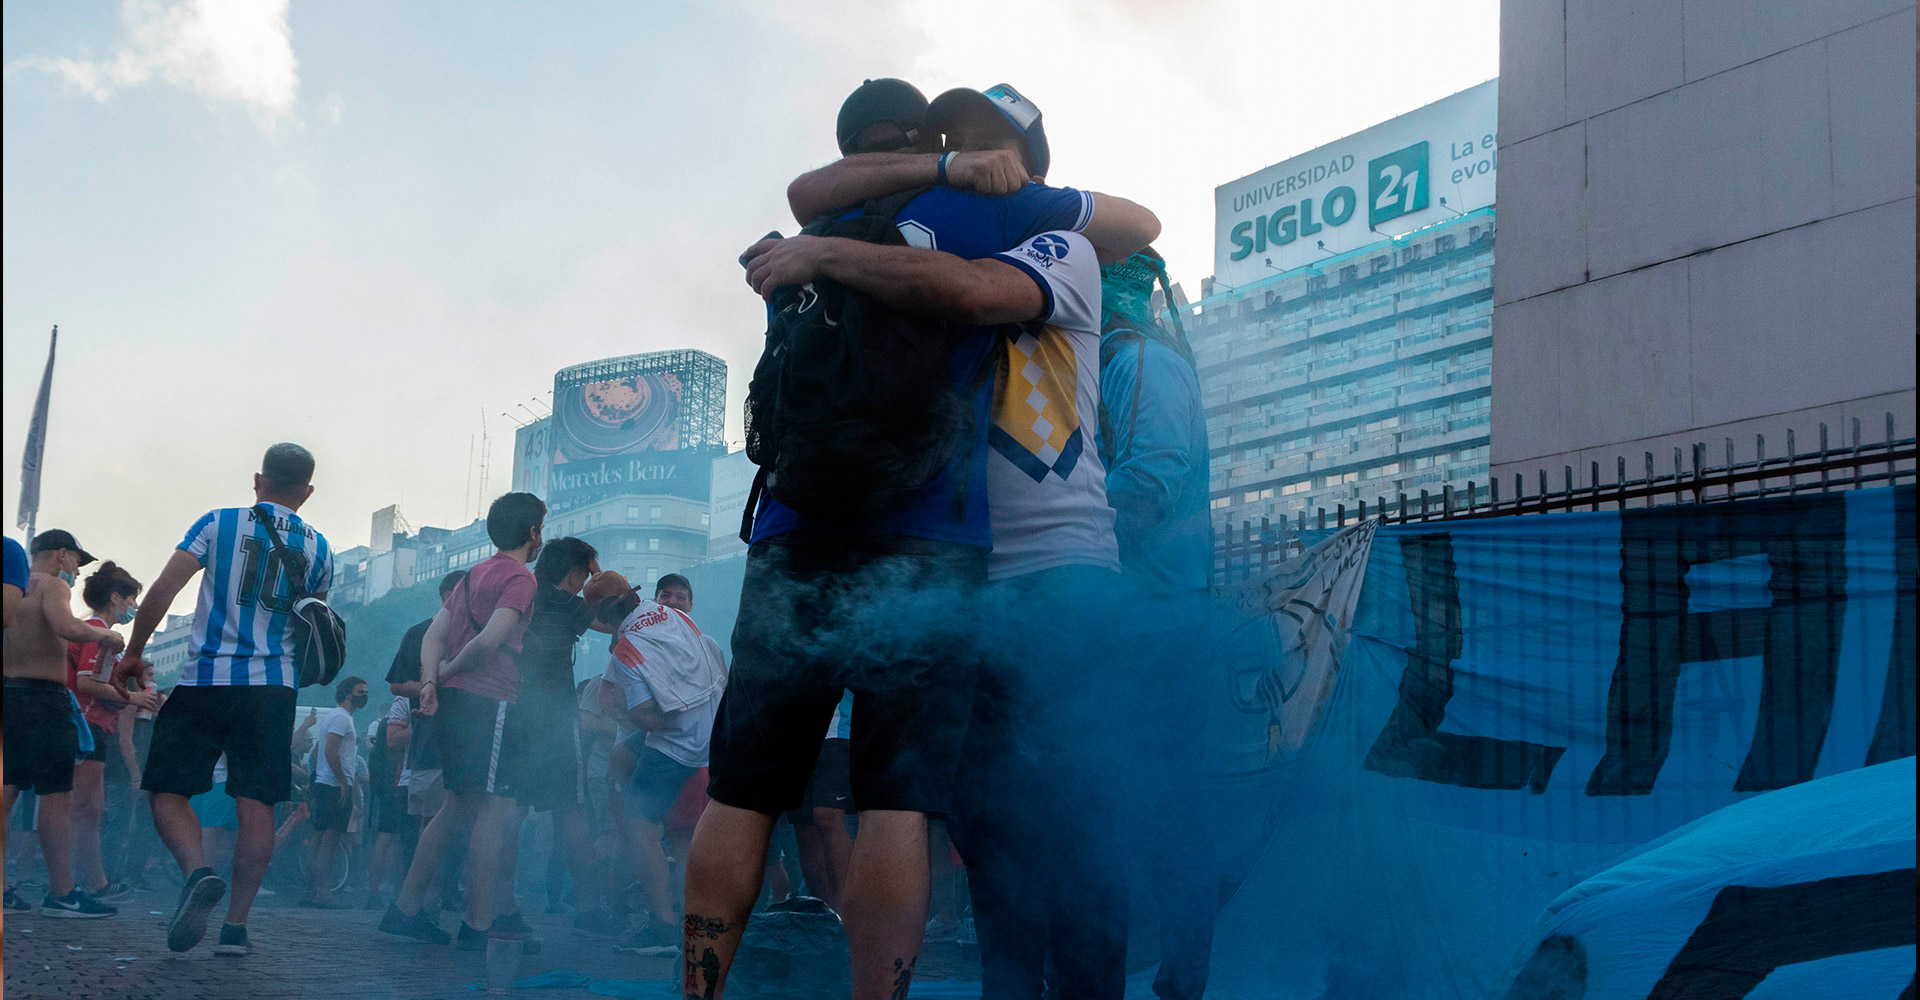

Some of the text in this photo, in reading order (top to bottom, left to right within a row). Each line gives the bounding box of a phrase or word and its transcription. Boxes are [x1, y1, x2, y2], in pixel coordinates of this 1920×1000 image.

[1451, 141, 1474, 161] La
[1451, 150, 1498, 184] evol
[1230, 164, 1419, 262] SIGLO 21
[1233, 154, 1355, 213] UNIVERSIDAD
[236, 534, 309, 616] 10
